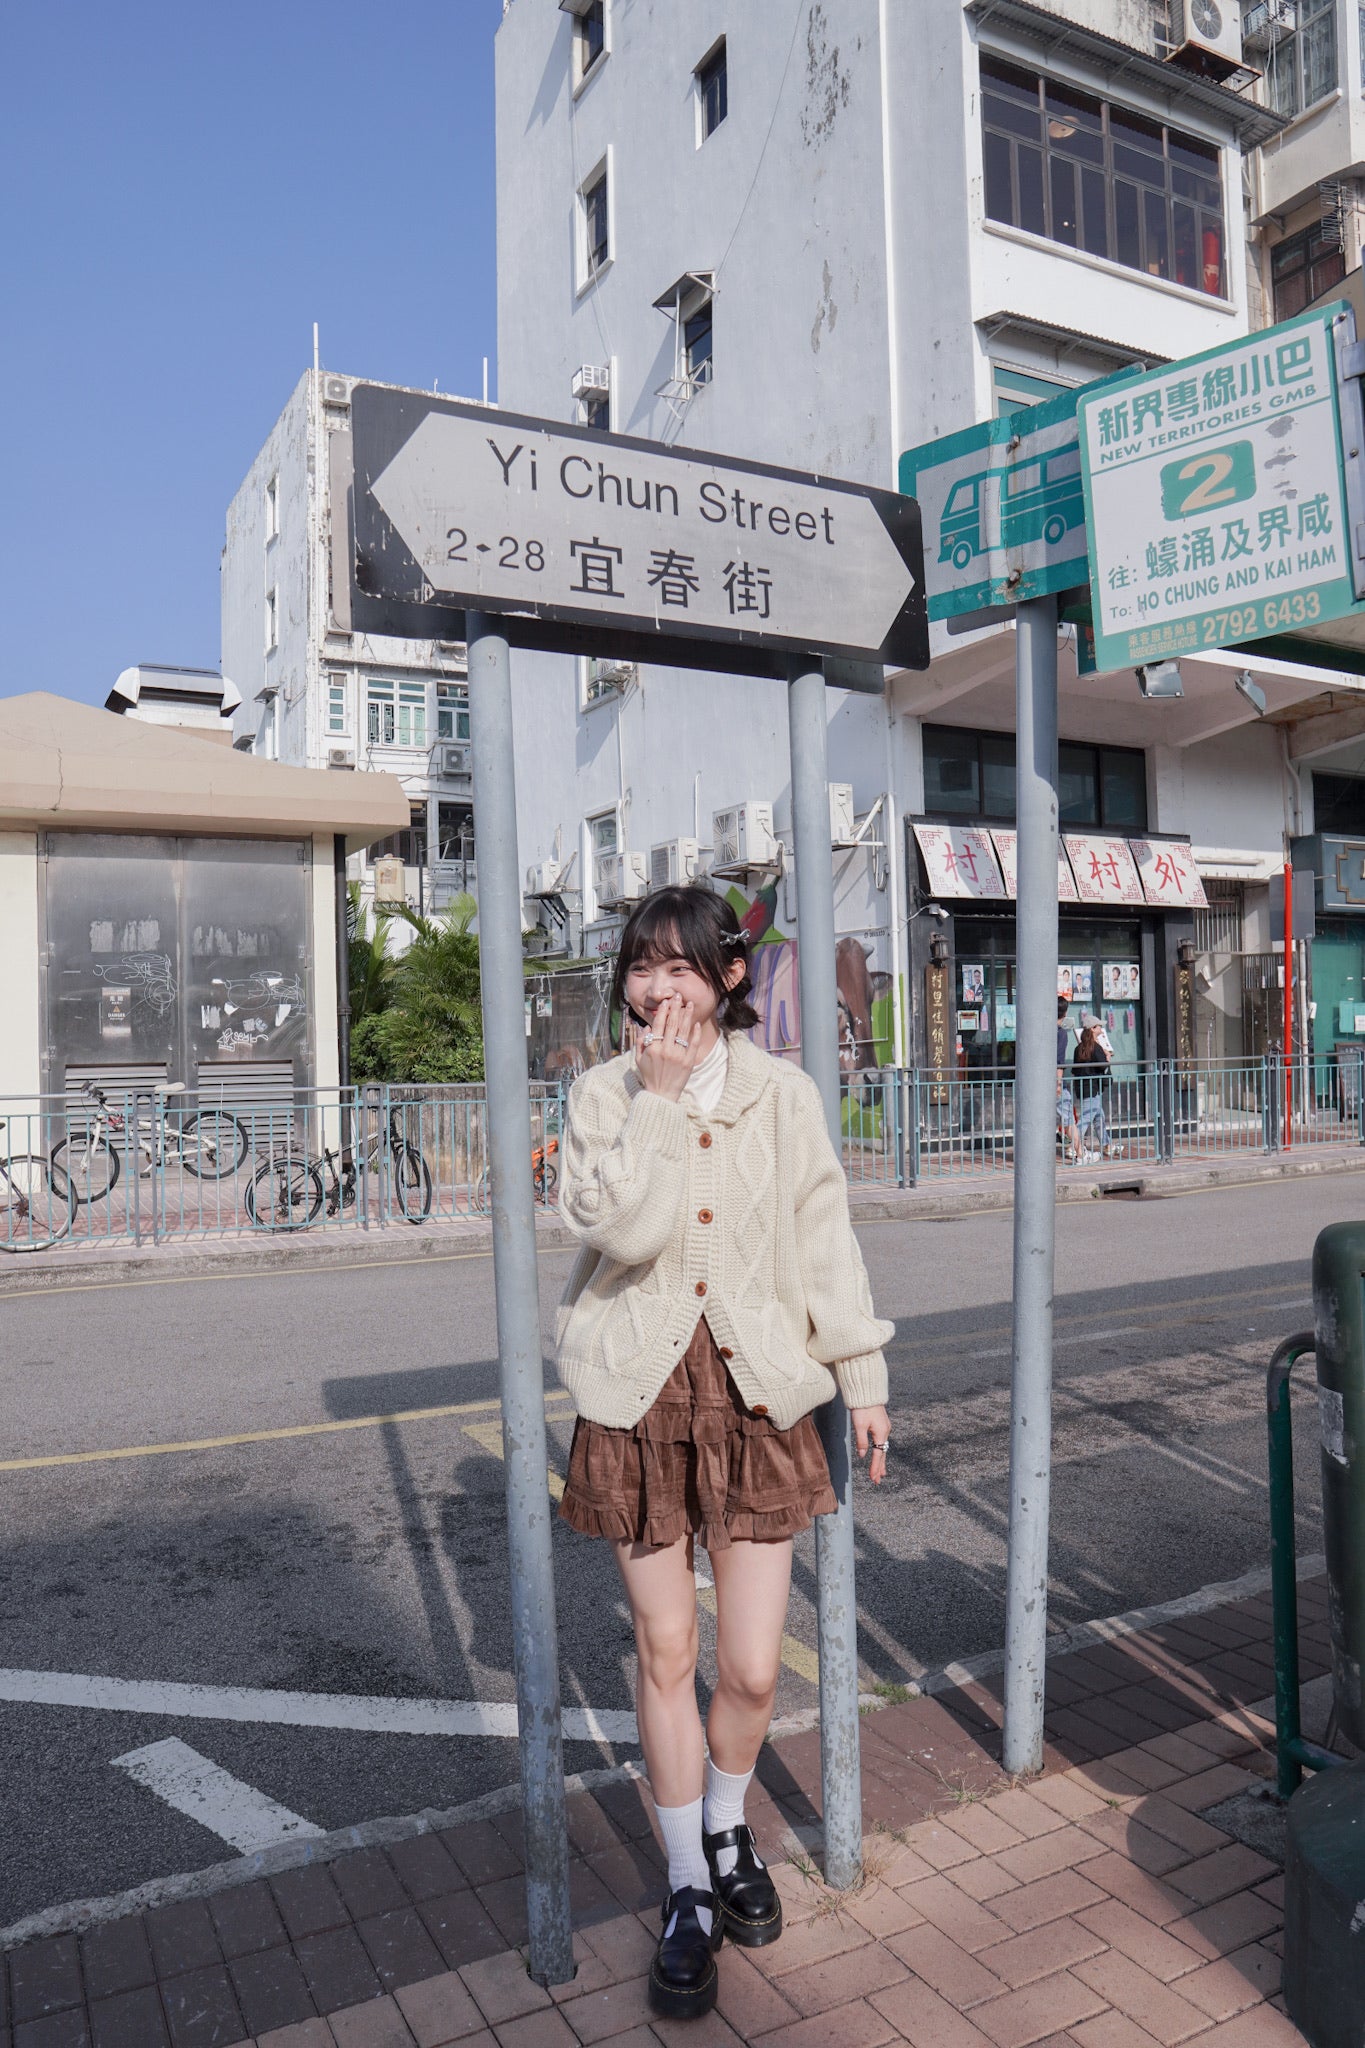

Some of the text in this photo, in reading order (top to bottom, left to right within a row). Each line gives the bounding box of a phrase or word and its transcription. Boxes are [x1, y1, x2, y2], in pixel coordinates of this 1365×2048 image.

[1098, 336, 1314, 447] 新界專線小巴
[1100, 384, 1316, 465] NEW TERRITORIES GMB
[486, 437, 836, 545] Yi Chun Street
[1178, 453, 1237, 512] 2
[569, 536, 773, 619] 宜春街
[1145, 492, 1333, 581] 蠔涌及界咸
[1110, 544, 1336, 619] To: HO CHUNG AND KAI HAM
[1203, 592, 1321, 643] 2792 6433
